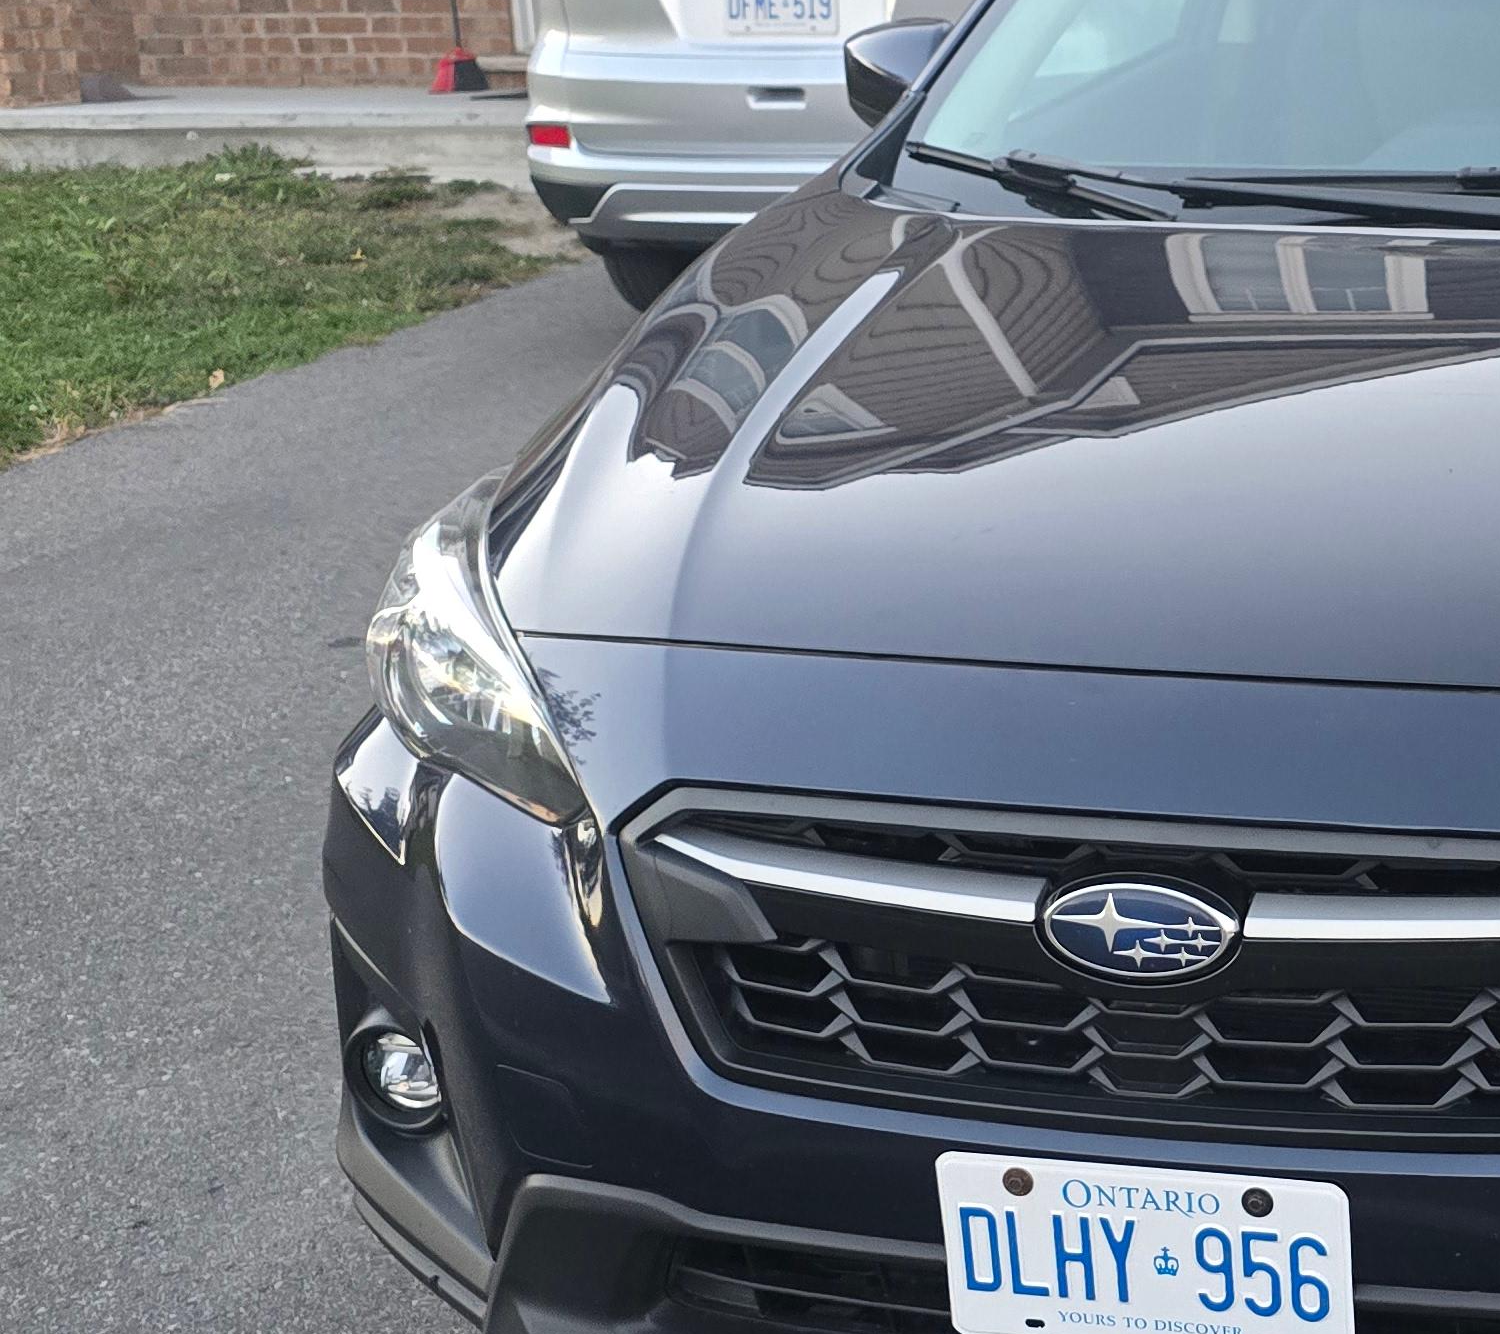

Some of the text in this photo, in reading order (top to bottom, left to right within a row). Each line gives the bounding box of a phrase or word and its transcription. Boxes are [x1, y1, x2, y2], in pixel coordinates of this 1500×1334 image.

[1062, 1179, 1220, 1217] ONTARIO
[959, 1205, 1331, 1323] DLHY 956
[1058, 1310, 1116, 1328] YOURS
[1123, 1316, 1148, 1330] TO
